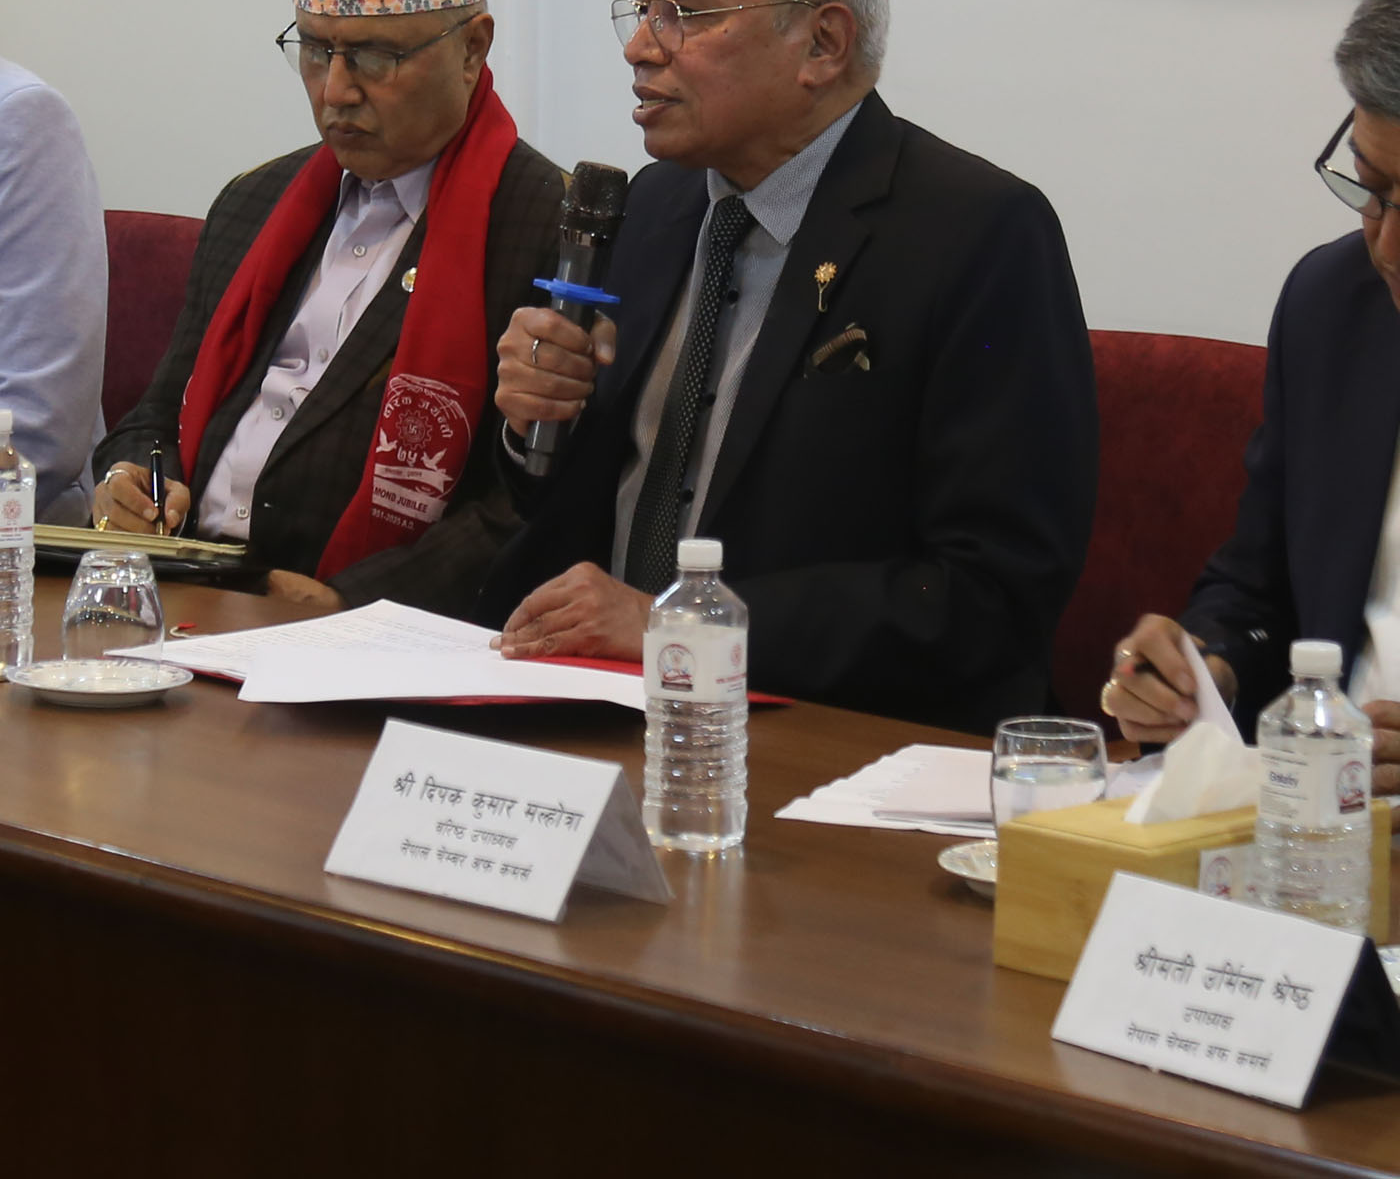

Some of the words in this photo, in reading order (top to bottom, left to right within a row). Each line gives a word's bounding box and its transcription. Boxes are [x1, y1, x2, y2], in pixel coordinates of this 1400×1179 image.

[373, 486, 398, 505] MOND
[397, 495, 429, 515] JUBILEE
[372, 508, 401, 527] 951-2025
[393, 772, 417, 798] श्री
[420, 775, 467, 807] दिपक
[471, 792, 519, 820] कुमार
[523, 801, 584, 833] मल्होत्रा
[400, 838, 432, 860] नेपाल
[1134, 946, 1196, 986] श्रीमती
[1202, 961, 1265, 1000] उर्मिला
[1271, 973, 1314, 1011] श्रेष्ठ
